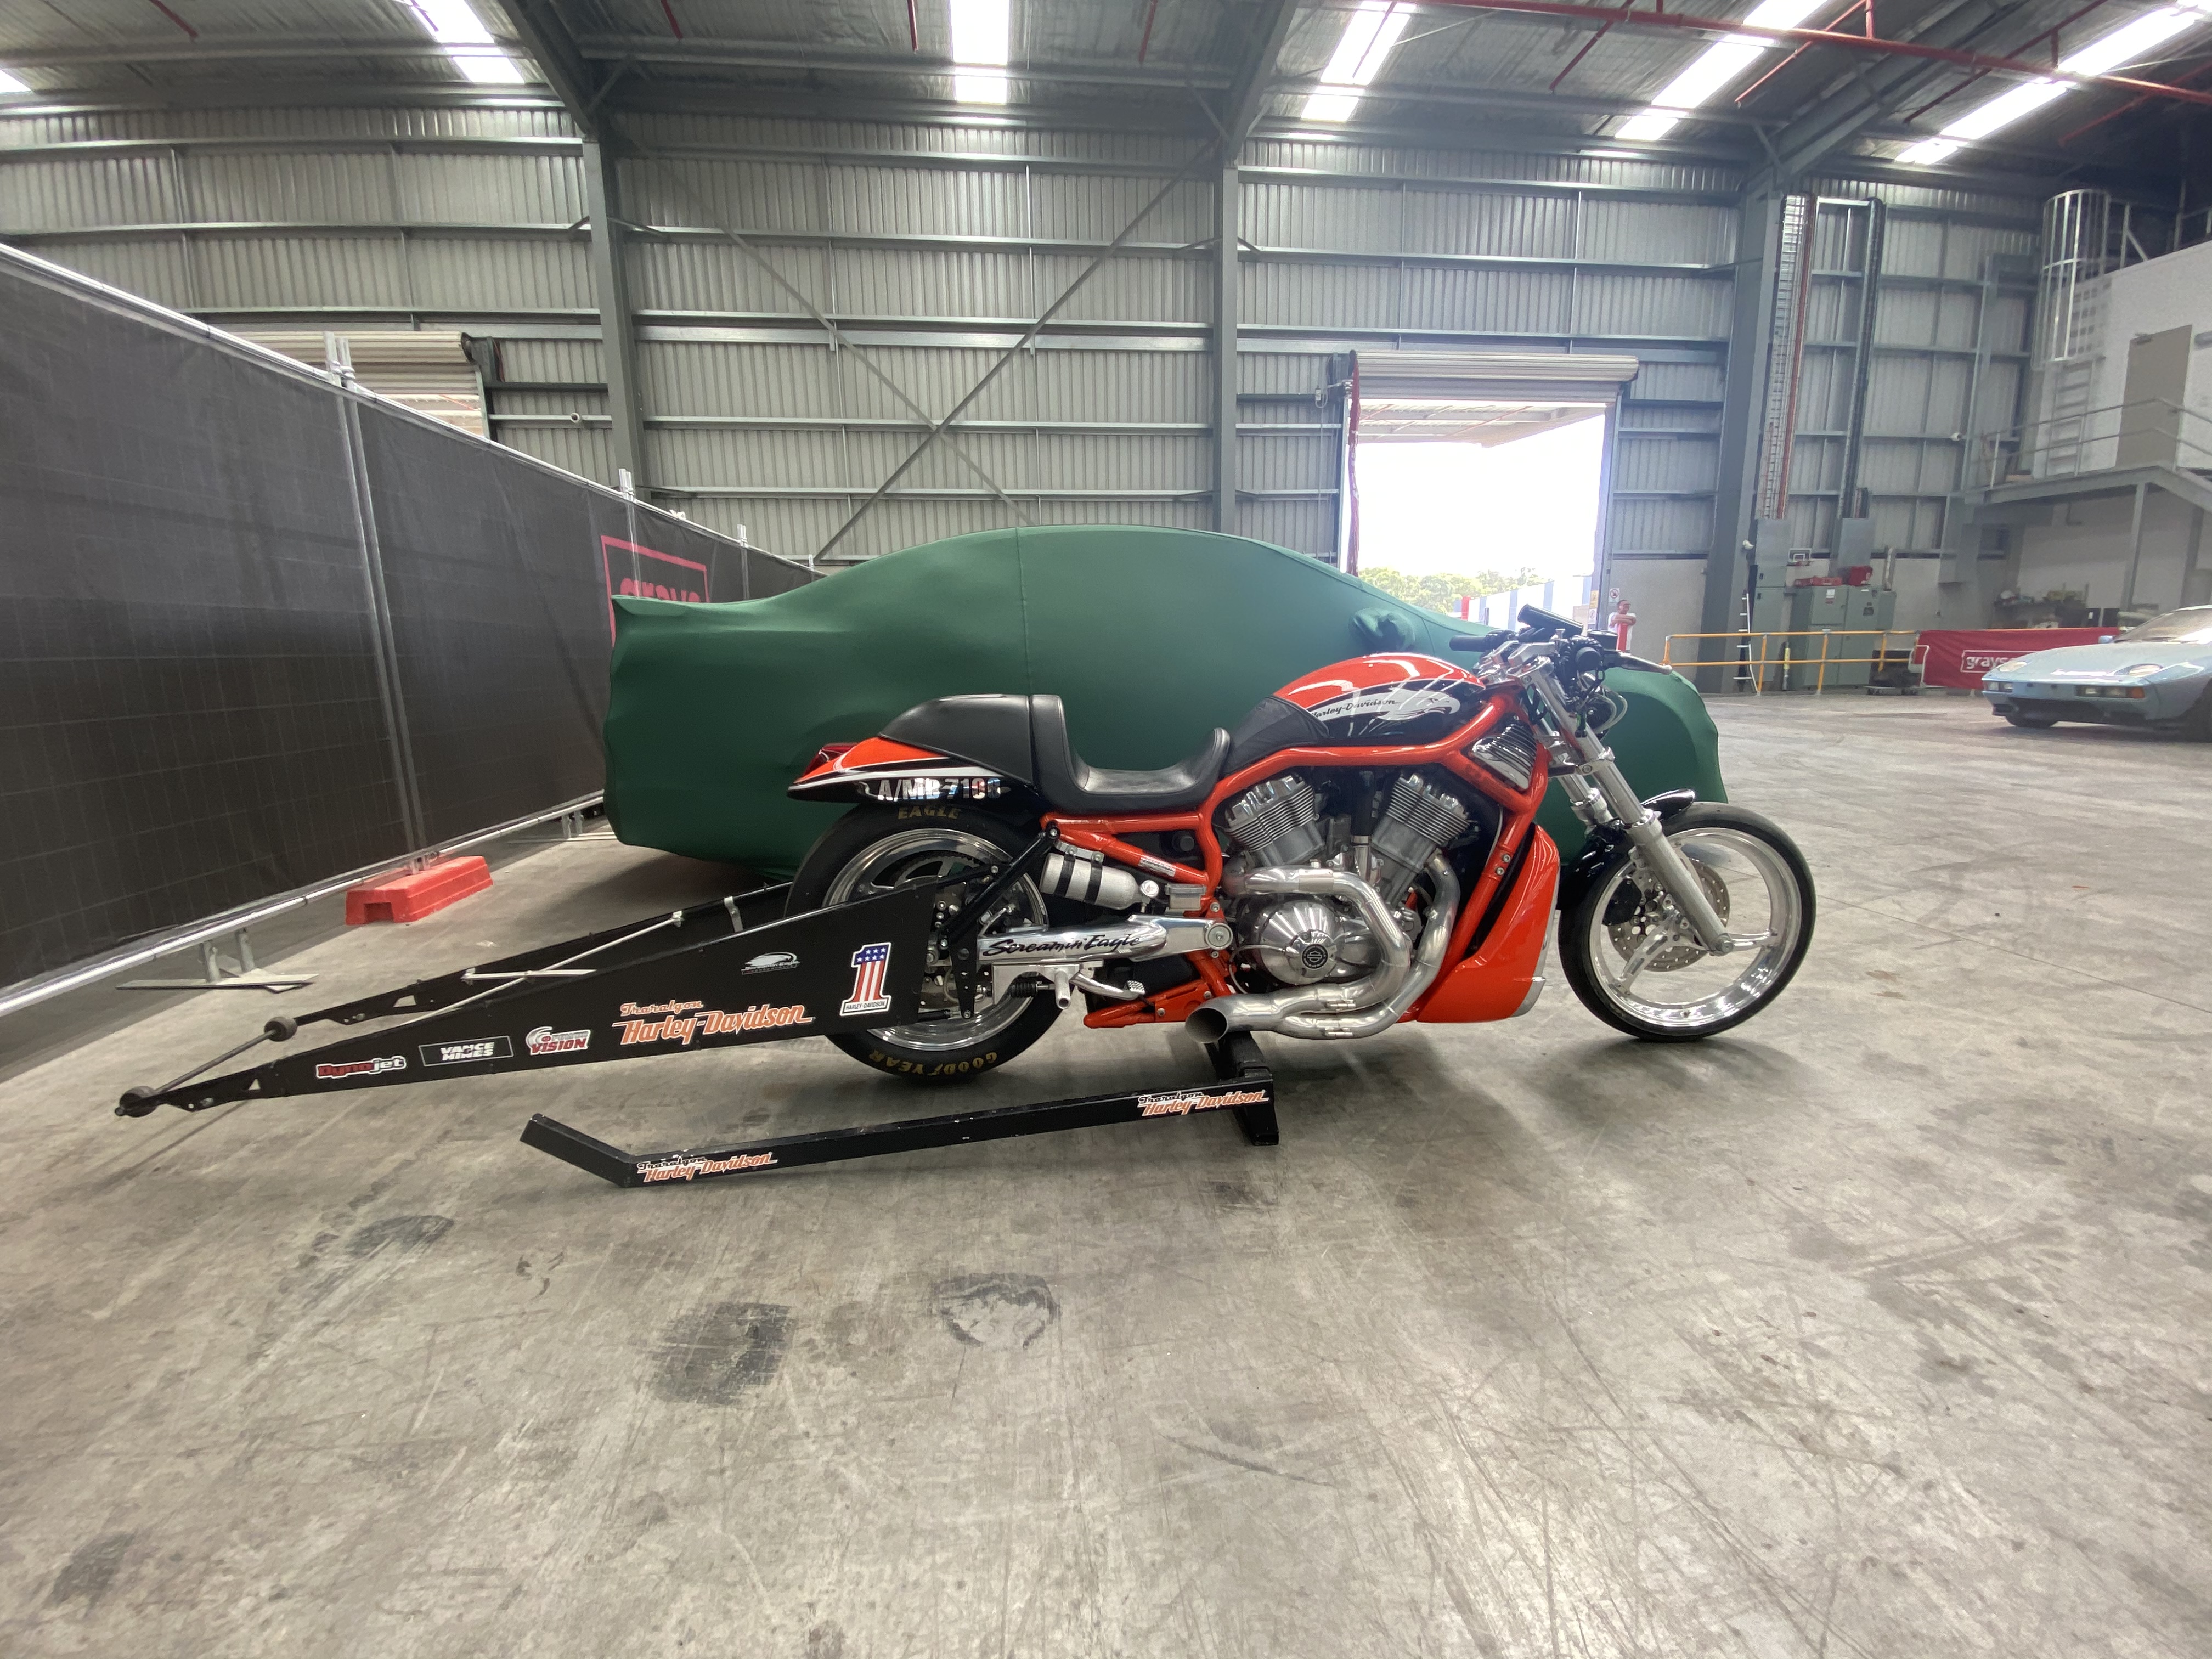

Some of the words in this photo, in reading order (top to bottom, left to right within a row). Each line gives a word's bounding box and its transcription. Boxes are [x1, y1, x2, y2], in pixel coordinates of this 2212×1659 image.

[898, 805, 960, 820] EAGLE
[1083, 934, 1140, 953] Eagle
[620, 1000, 704, 1016] Traralgon
[612, 1004, 815, 1045] Harley-Davidson
[440, 1042, 494, 1054] VANCE
[532, 1038, 587, 1053] VISION
[1137, 1091, 1269, 1117] Harley-Davidson
[637, 1154, 778, 1183] Harley-Davidson
